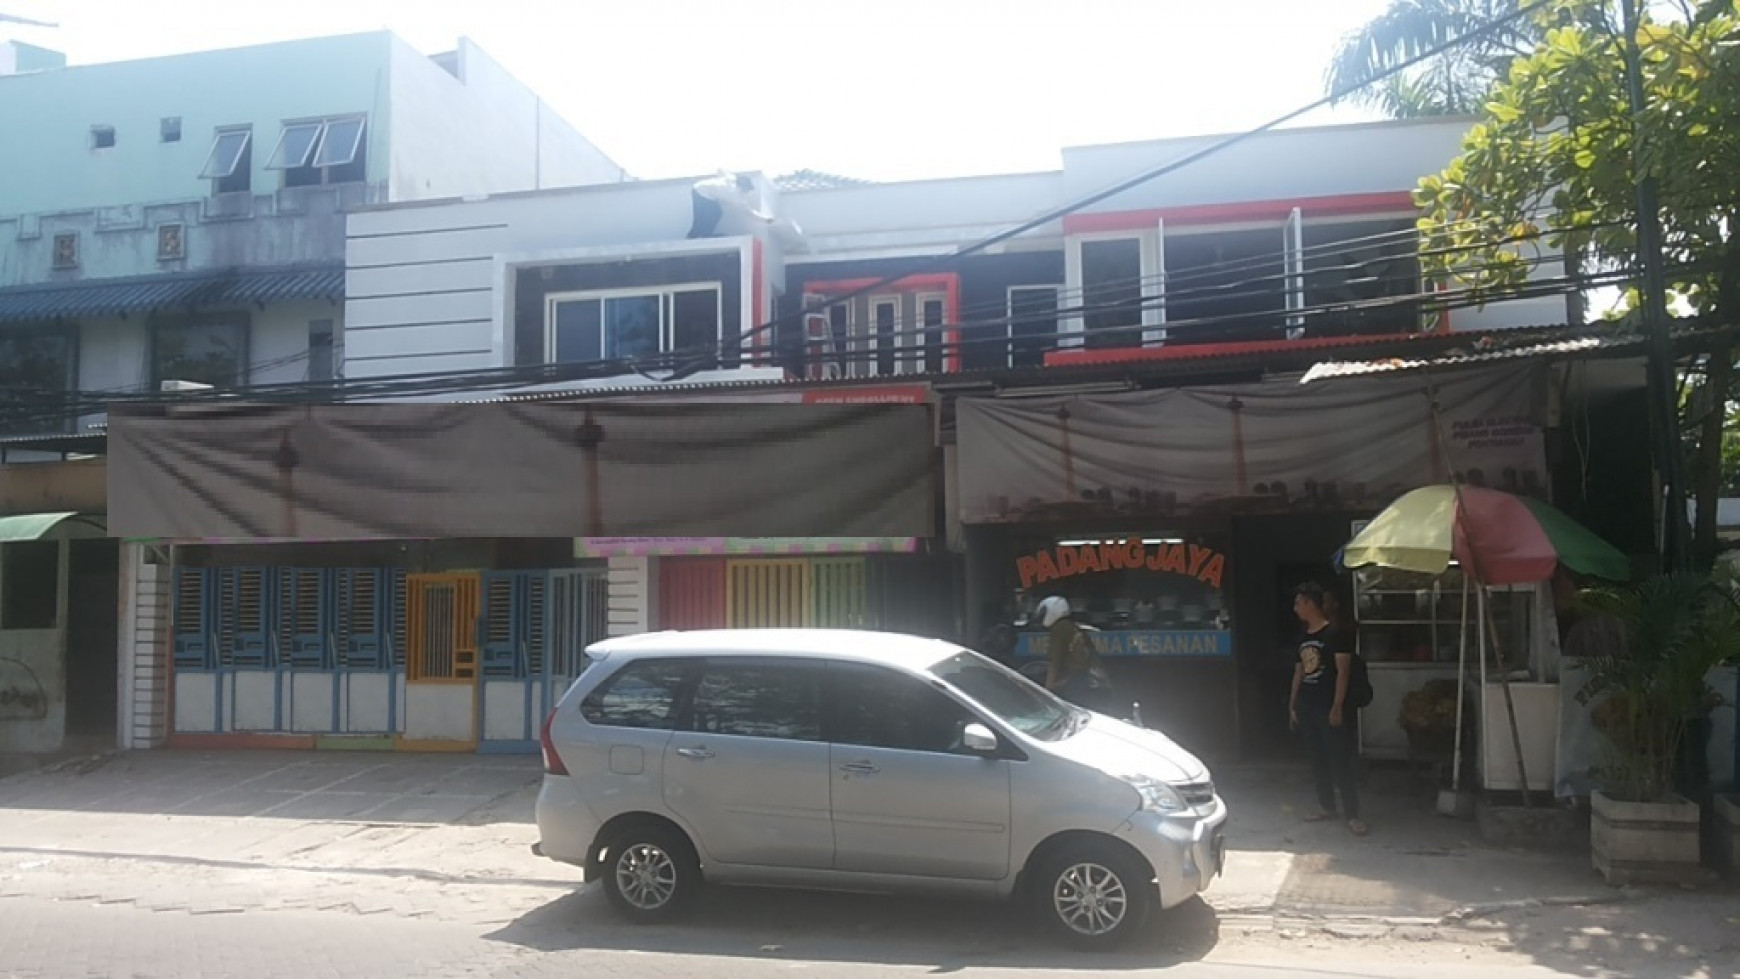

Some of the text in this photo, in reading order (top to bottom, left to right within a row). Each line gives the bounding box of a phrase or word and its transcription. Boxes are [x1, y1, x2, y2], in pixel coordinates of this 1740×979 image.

[1016, 537, 1224, 588] PADANG JAYA
[1127, 633, 1218, 654] PESANAN
